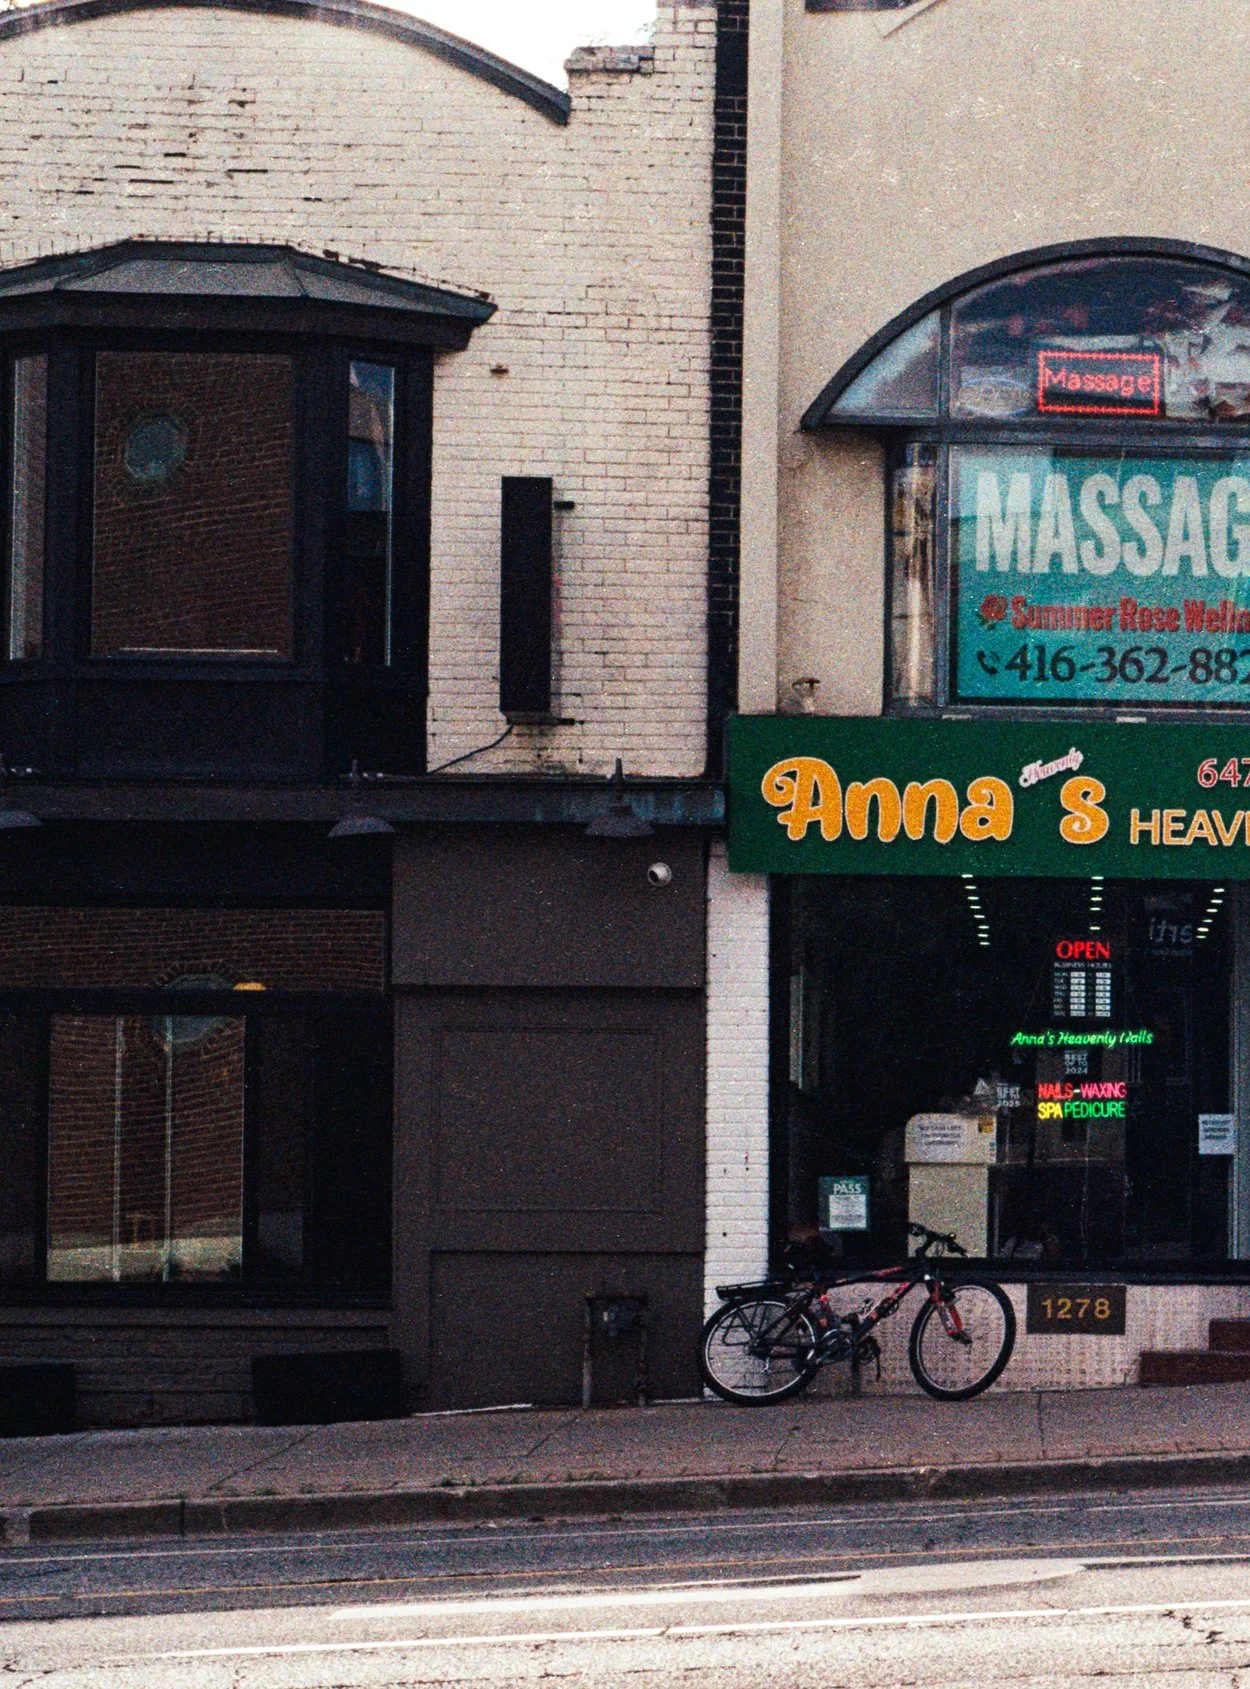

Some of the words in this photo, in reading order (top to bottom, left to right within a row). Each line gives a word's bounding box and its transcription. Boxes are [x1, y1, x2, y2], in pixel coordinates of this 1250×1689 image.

[1044, 367, 1151, 397] Massage
[1011, 595, 1117, 631] Summer
[1119, 597, 1180, 632] Rose
[1019, 747, 1084, 787] Heavenly
[1056, 941, 1110, 959] OPEN
[1011, 1030, 1055, 1045] Anna's
[1057, 1030, 1116, 1048] Heavenly
[1119, 1030, 1153, 1044] Nails
[1038, 1102, 1063, 1119] SPA
[1064, 1101, 1125, 1118] PEDICURE
[833, 1183, 861, 1194] PASS
[1041, 1297, 1111, 1319] 1278
